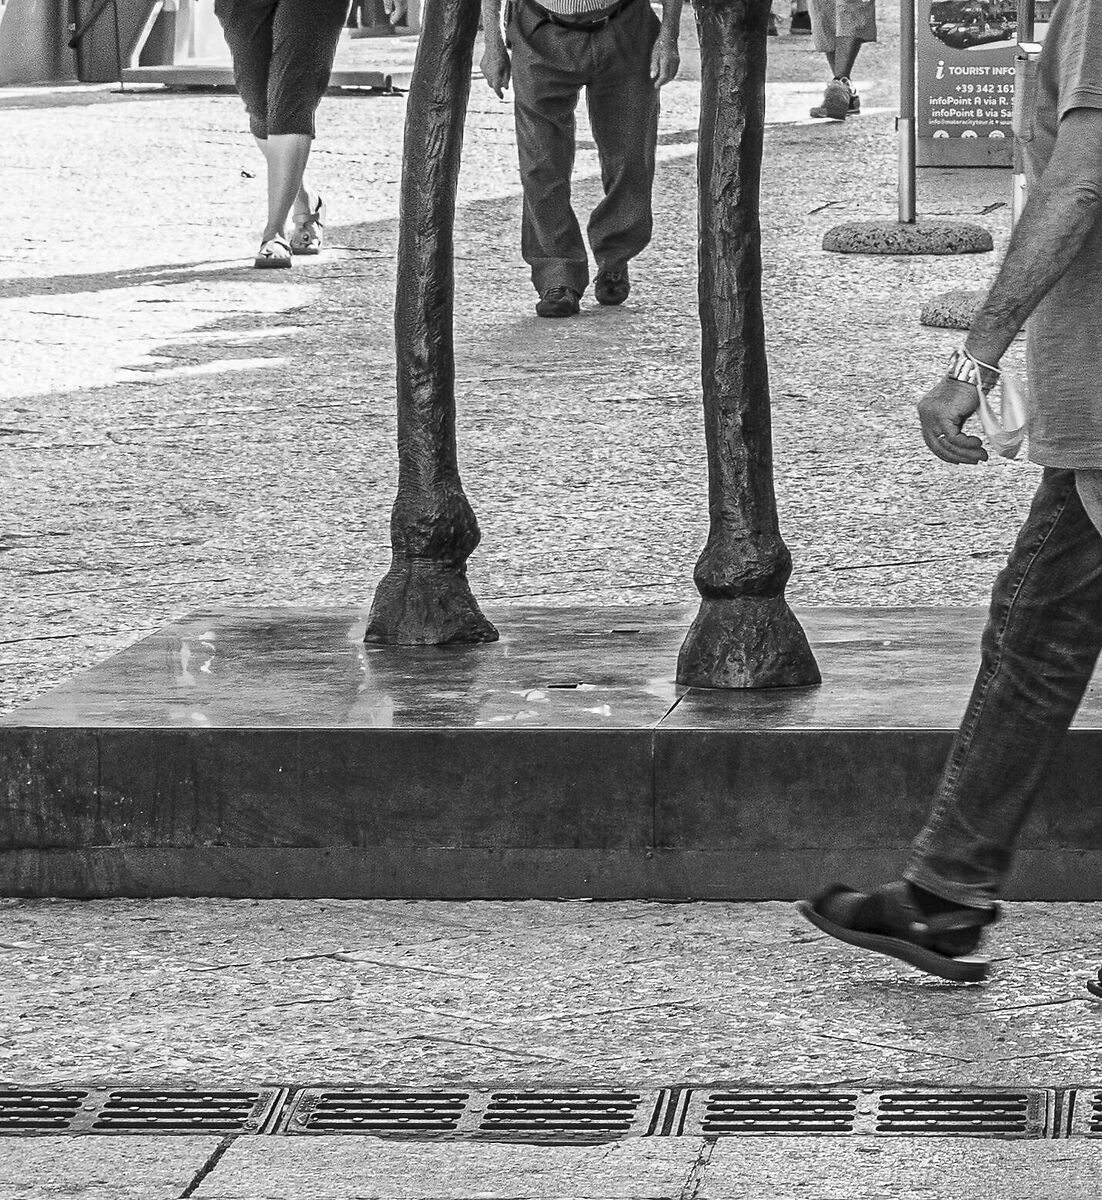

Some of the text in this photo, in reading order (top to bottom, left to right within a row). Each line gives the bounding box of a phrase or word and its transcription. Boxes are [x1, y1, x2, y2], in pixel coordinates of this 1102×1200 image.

[948, 66, 991, 76] TOURIST
[955, 84, 974, 93] +39
[976, 84, 995, 93] 342
[929, 96, 973, 105] infoPoint
[974, 97, 981, 105] A
[983, 96, 997, 105] via
[999, 97, 1009, 105] R.
[931, 108, 974, 118] infoPoint
[976, 109, 983, 118] B
[985, 108, 999, 118] via
